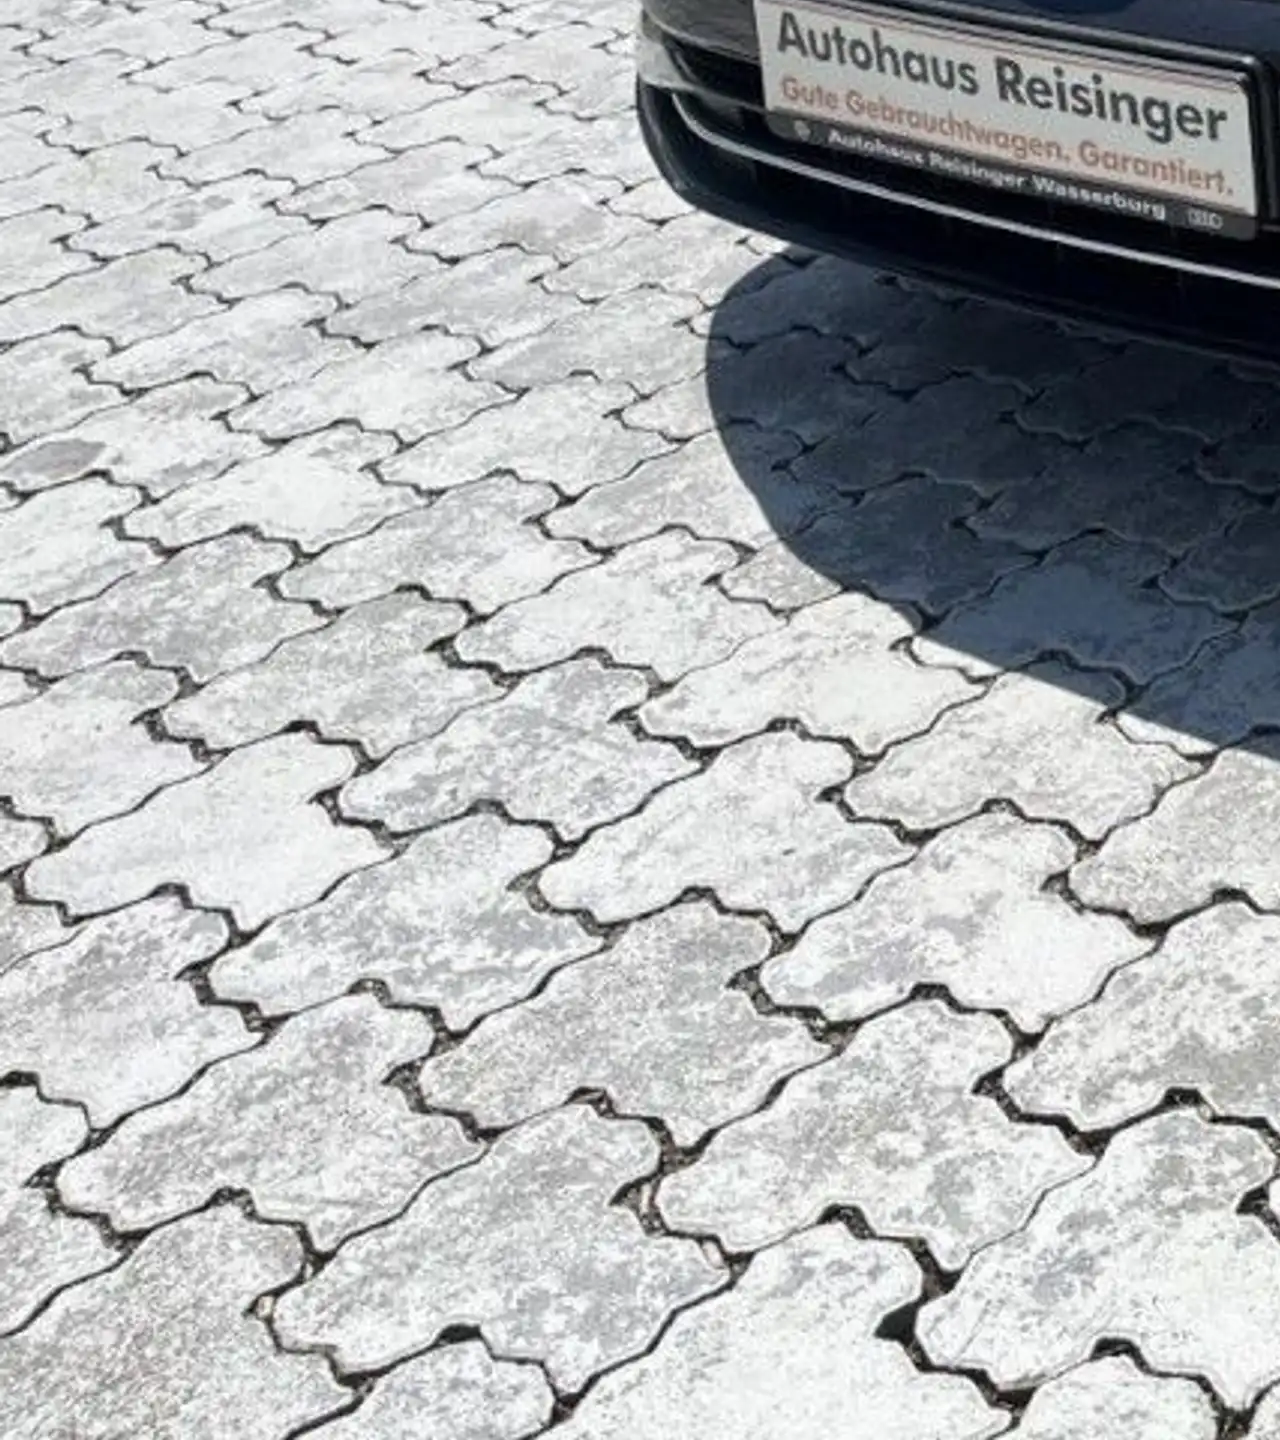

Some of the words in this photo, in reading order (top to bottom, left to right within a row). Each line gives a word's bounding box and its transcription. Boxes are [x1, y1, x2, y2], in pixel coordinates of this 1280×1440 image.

[778, 10, 980, 96] Autohaus
[993, 56, 1228, 144] Reisinger
[780, 76, 839, 111] Gute
[845, 88, 1071, 160] Gebrauchtwagen.
[1077, 139, 1235, 196] Garantiert.
[827, 128, 925, 165] Autohaus
[929, 149, 1026, 188] Reisinger
[1030, 173, 1167, 221] Wasserburg
